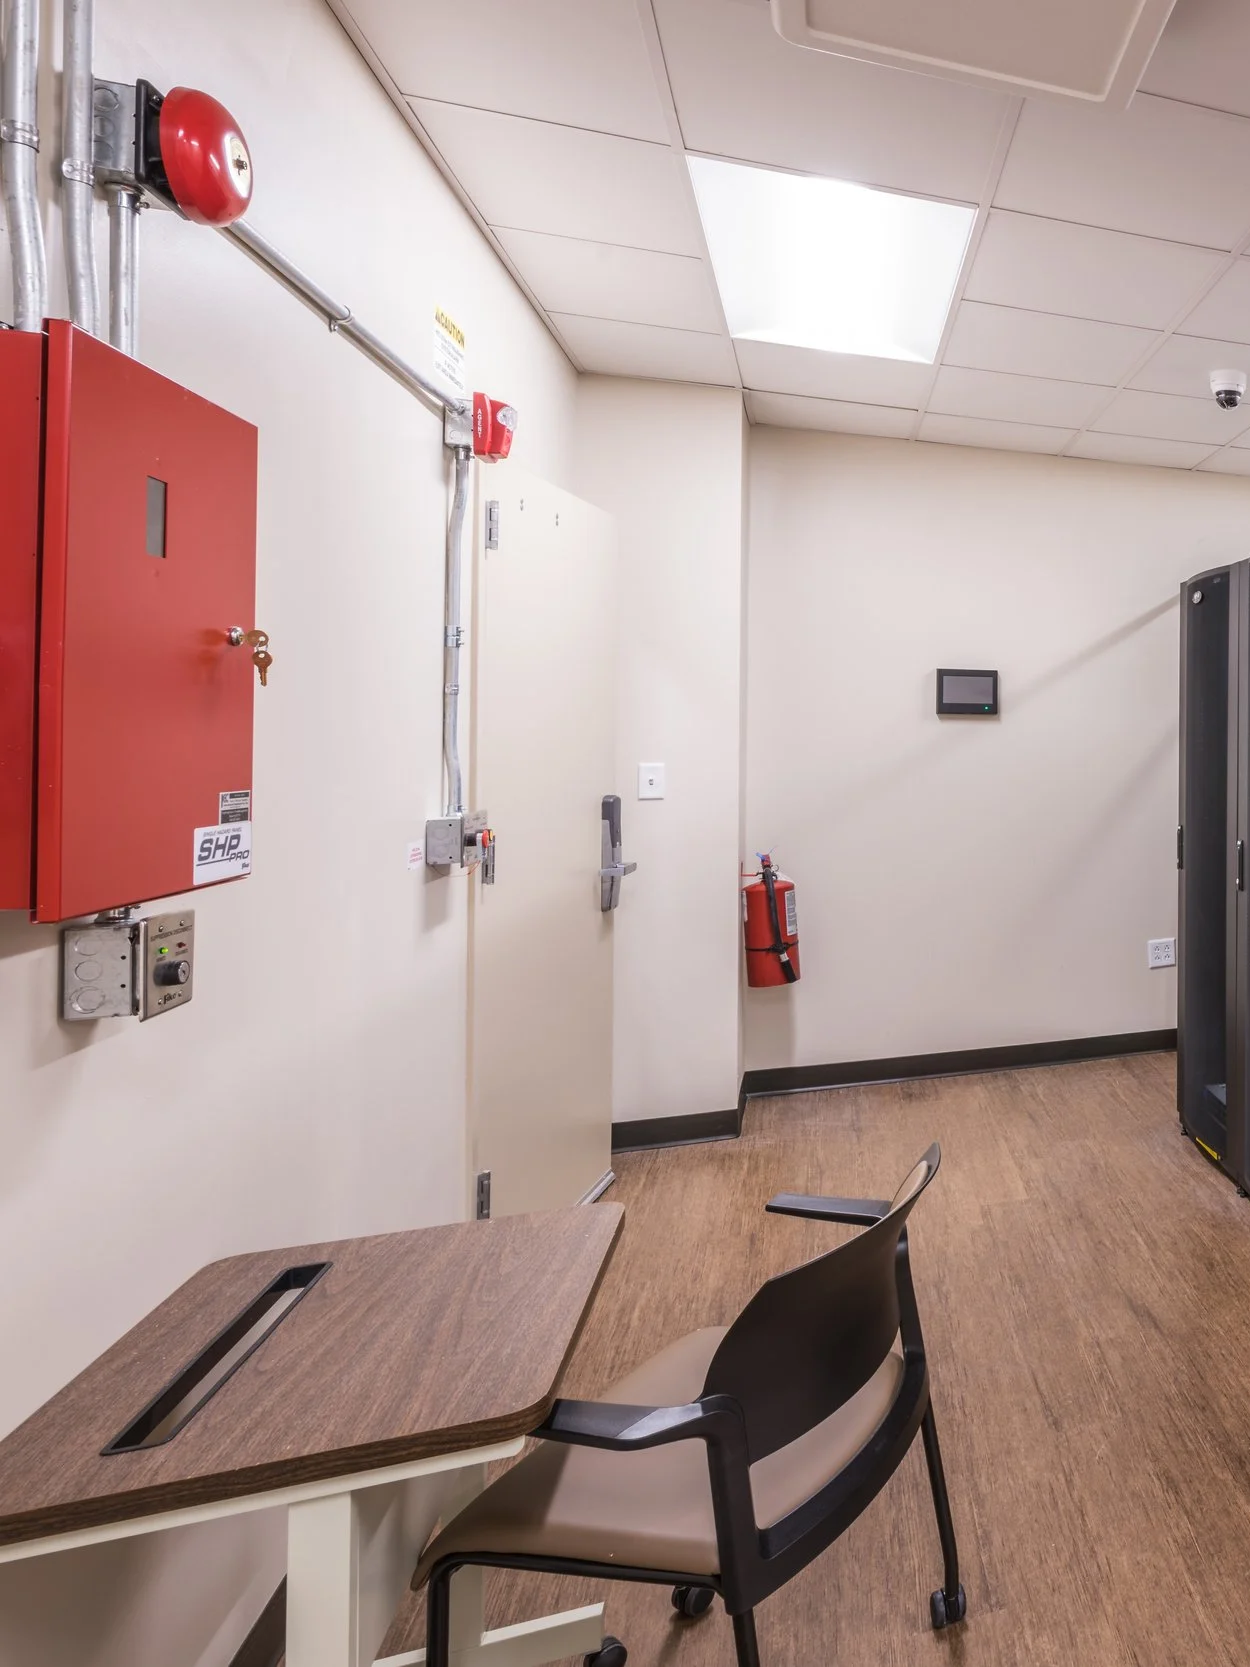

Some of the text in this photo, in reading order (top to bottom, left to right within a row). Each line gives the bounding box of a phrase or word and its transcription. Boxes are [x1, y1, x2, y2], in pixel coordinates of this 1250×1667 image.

[440, 311, 465, 349] CAUTION
[198, 834, 241, 861] SHP
[229, 850, 249, 862] PRO
